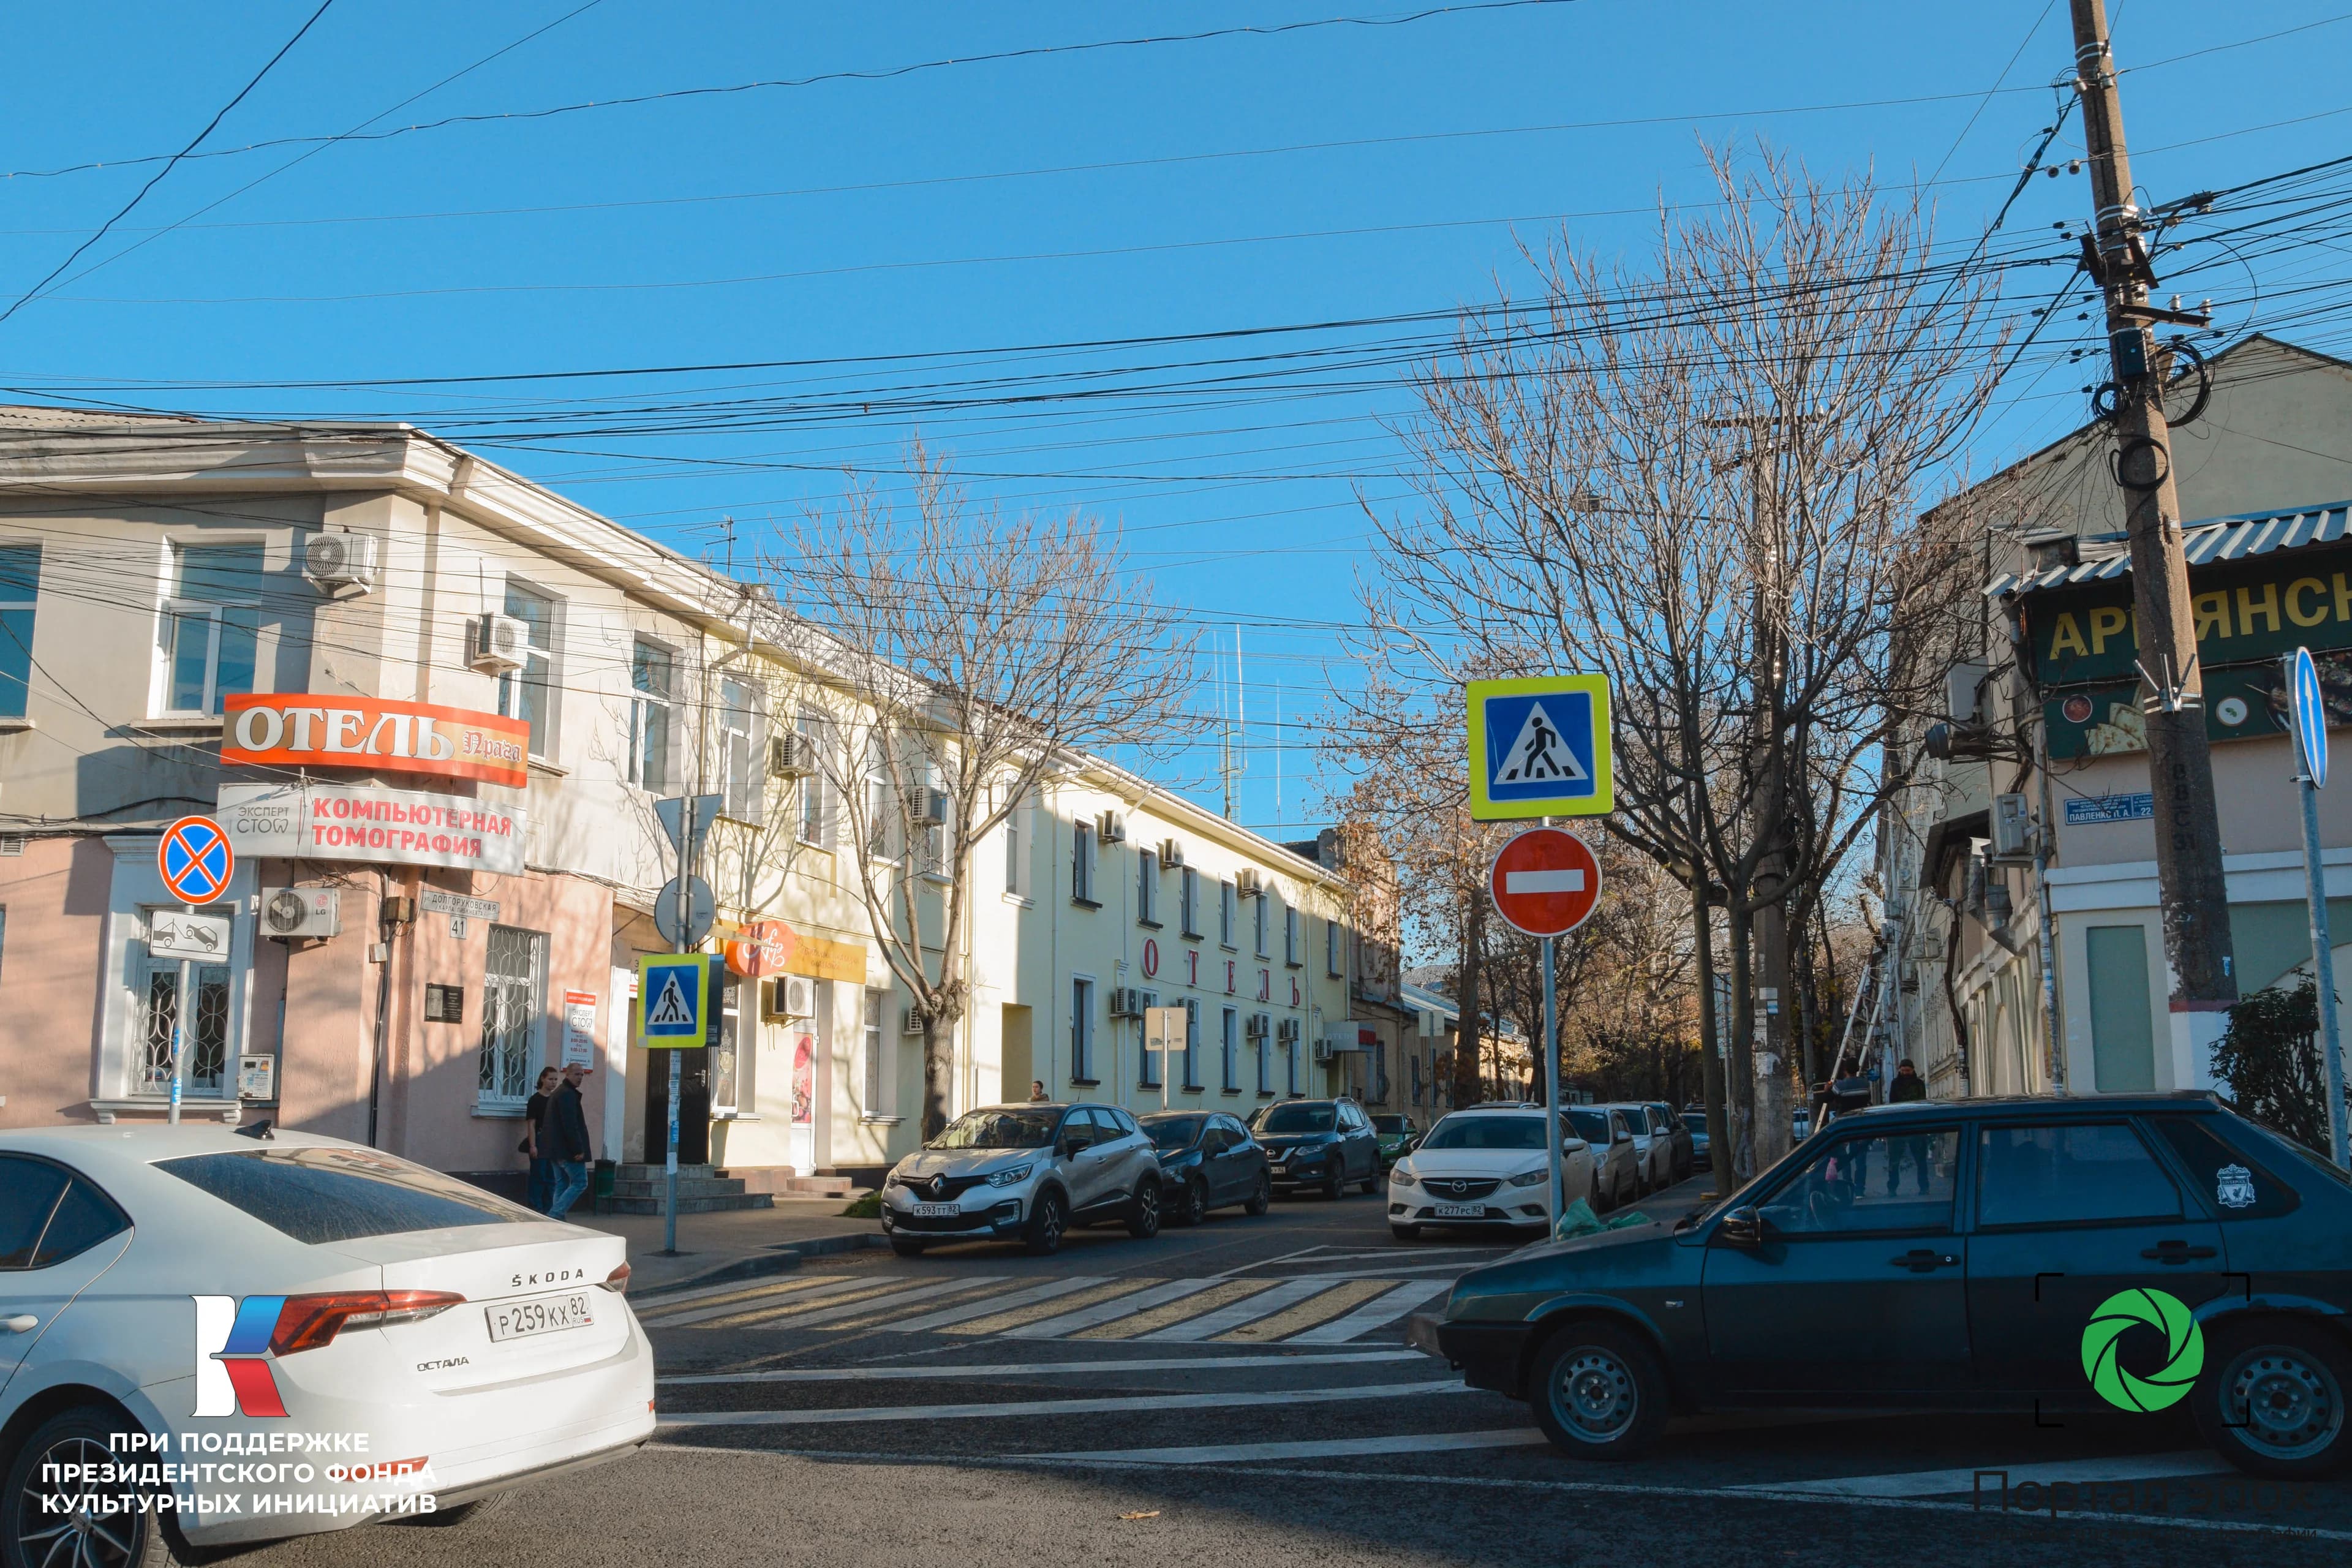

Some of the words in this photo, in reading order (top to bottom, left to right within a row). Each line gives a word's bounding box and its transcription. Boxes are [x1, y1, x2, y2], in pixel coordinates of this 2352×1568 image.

[2049, 572, 2352, 660] АРЯНС
[235, 706, 454, 761] ОТЕЛЬ
[462, 731, 521, 763] Прага
[238, 807, 290, 816] ЭКСПЕРТ
[314, 798, 512, 837] КОМПЬЮТЕРНАЯ
[313, 824, 482, 858] ТОМОГРАФИЯ
[432, 894, 497, 911] ДОЛГОРУКОВСКАЯ
[451, 920, 464, 936] 41
[1140, 938, 1300, 1008] ОТЕЛЬ
[916, 1206, 946, 1215] К593ТТ
[1438, 1207, 1471, 1215] К277РС
[511, 1268, 584, 1287] ŠKODA
[499, 1304, 570, 1335] Р259КХ
[570, 1297, 586, 1316] 82
[417, 1357, 469, 1371] OCTAVIA
